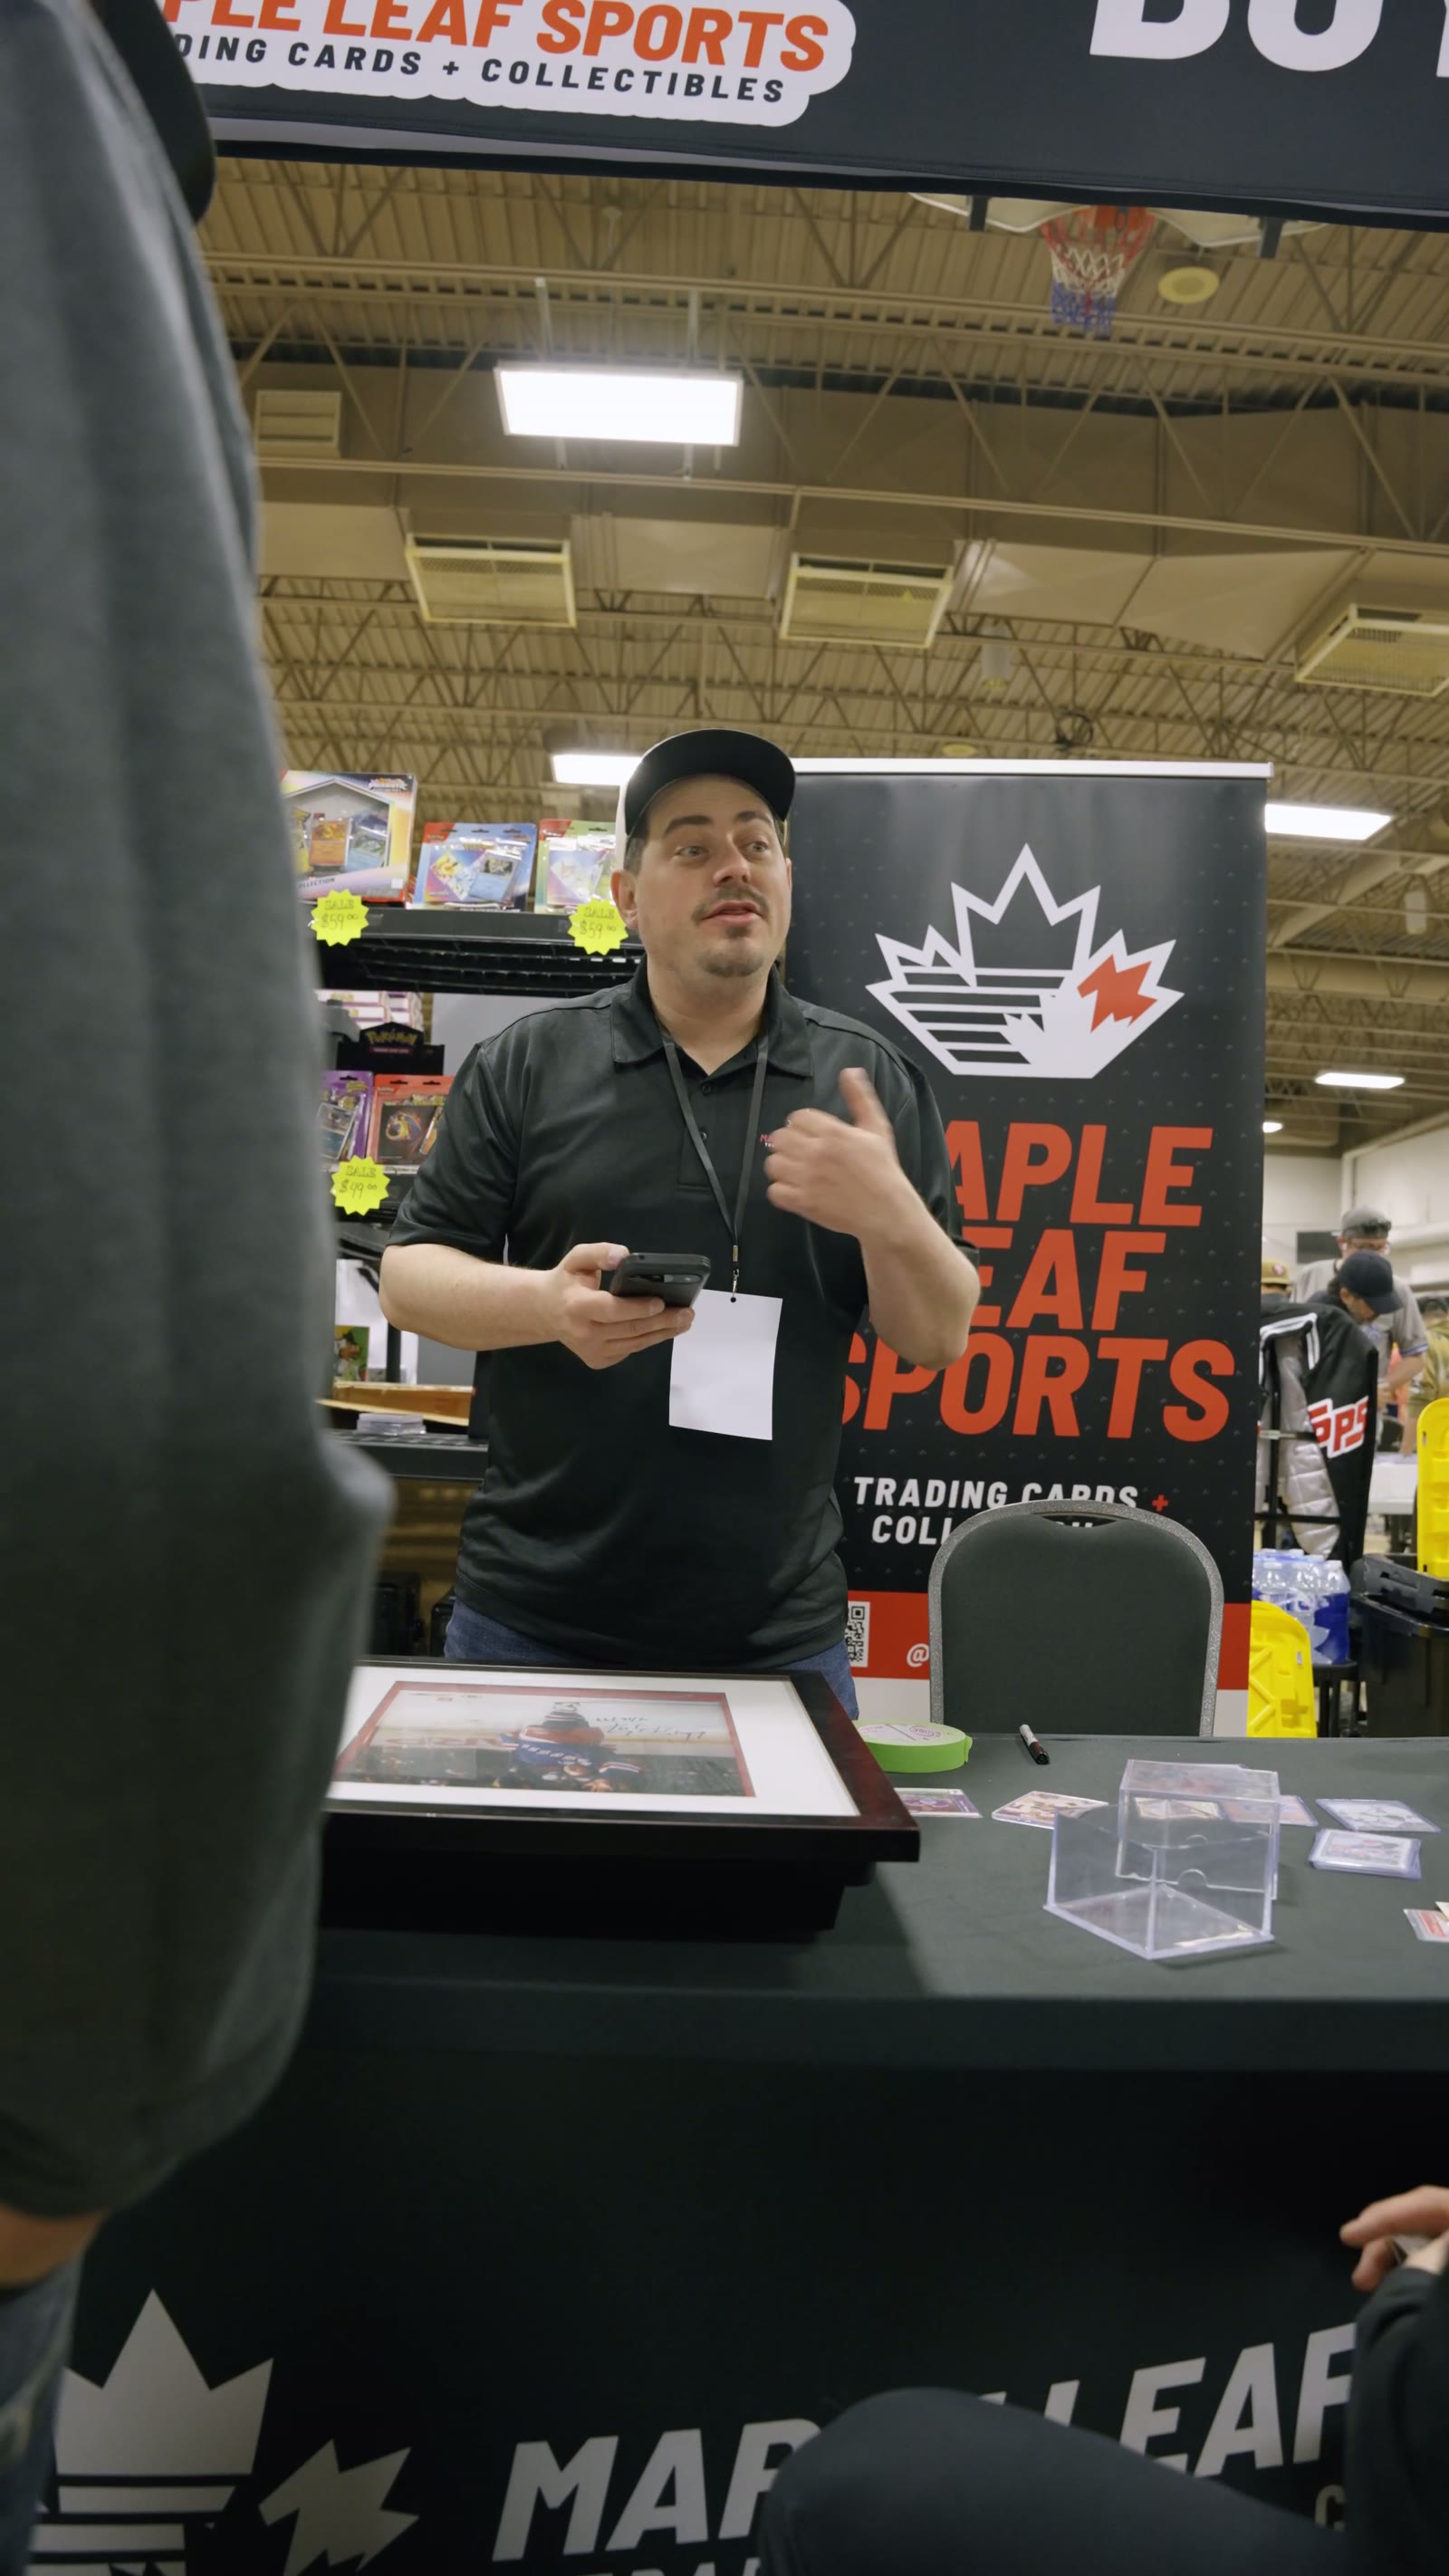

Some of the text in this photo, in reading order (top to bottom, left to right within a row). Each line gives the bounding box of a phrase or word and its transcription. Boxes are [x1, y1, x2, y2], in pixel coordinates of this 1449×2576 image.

[175, 34, 267, 63] DING
[288, 42, 421, 75] CARDS
[481, 59, 785, 103] COLLECTIBLES
[322, 0, 523, 48] LEAF
[536, 0, 830, 72] SPORTS
[945, 1120, 1214, 1227] APLE
[853, 1476, 1008, 1510] TRADING
